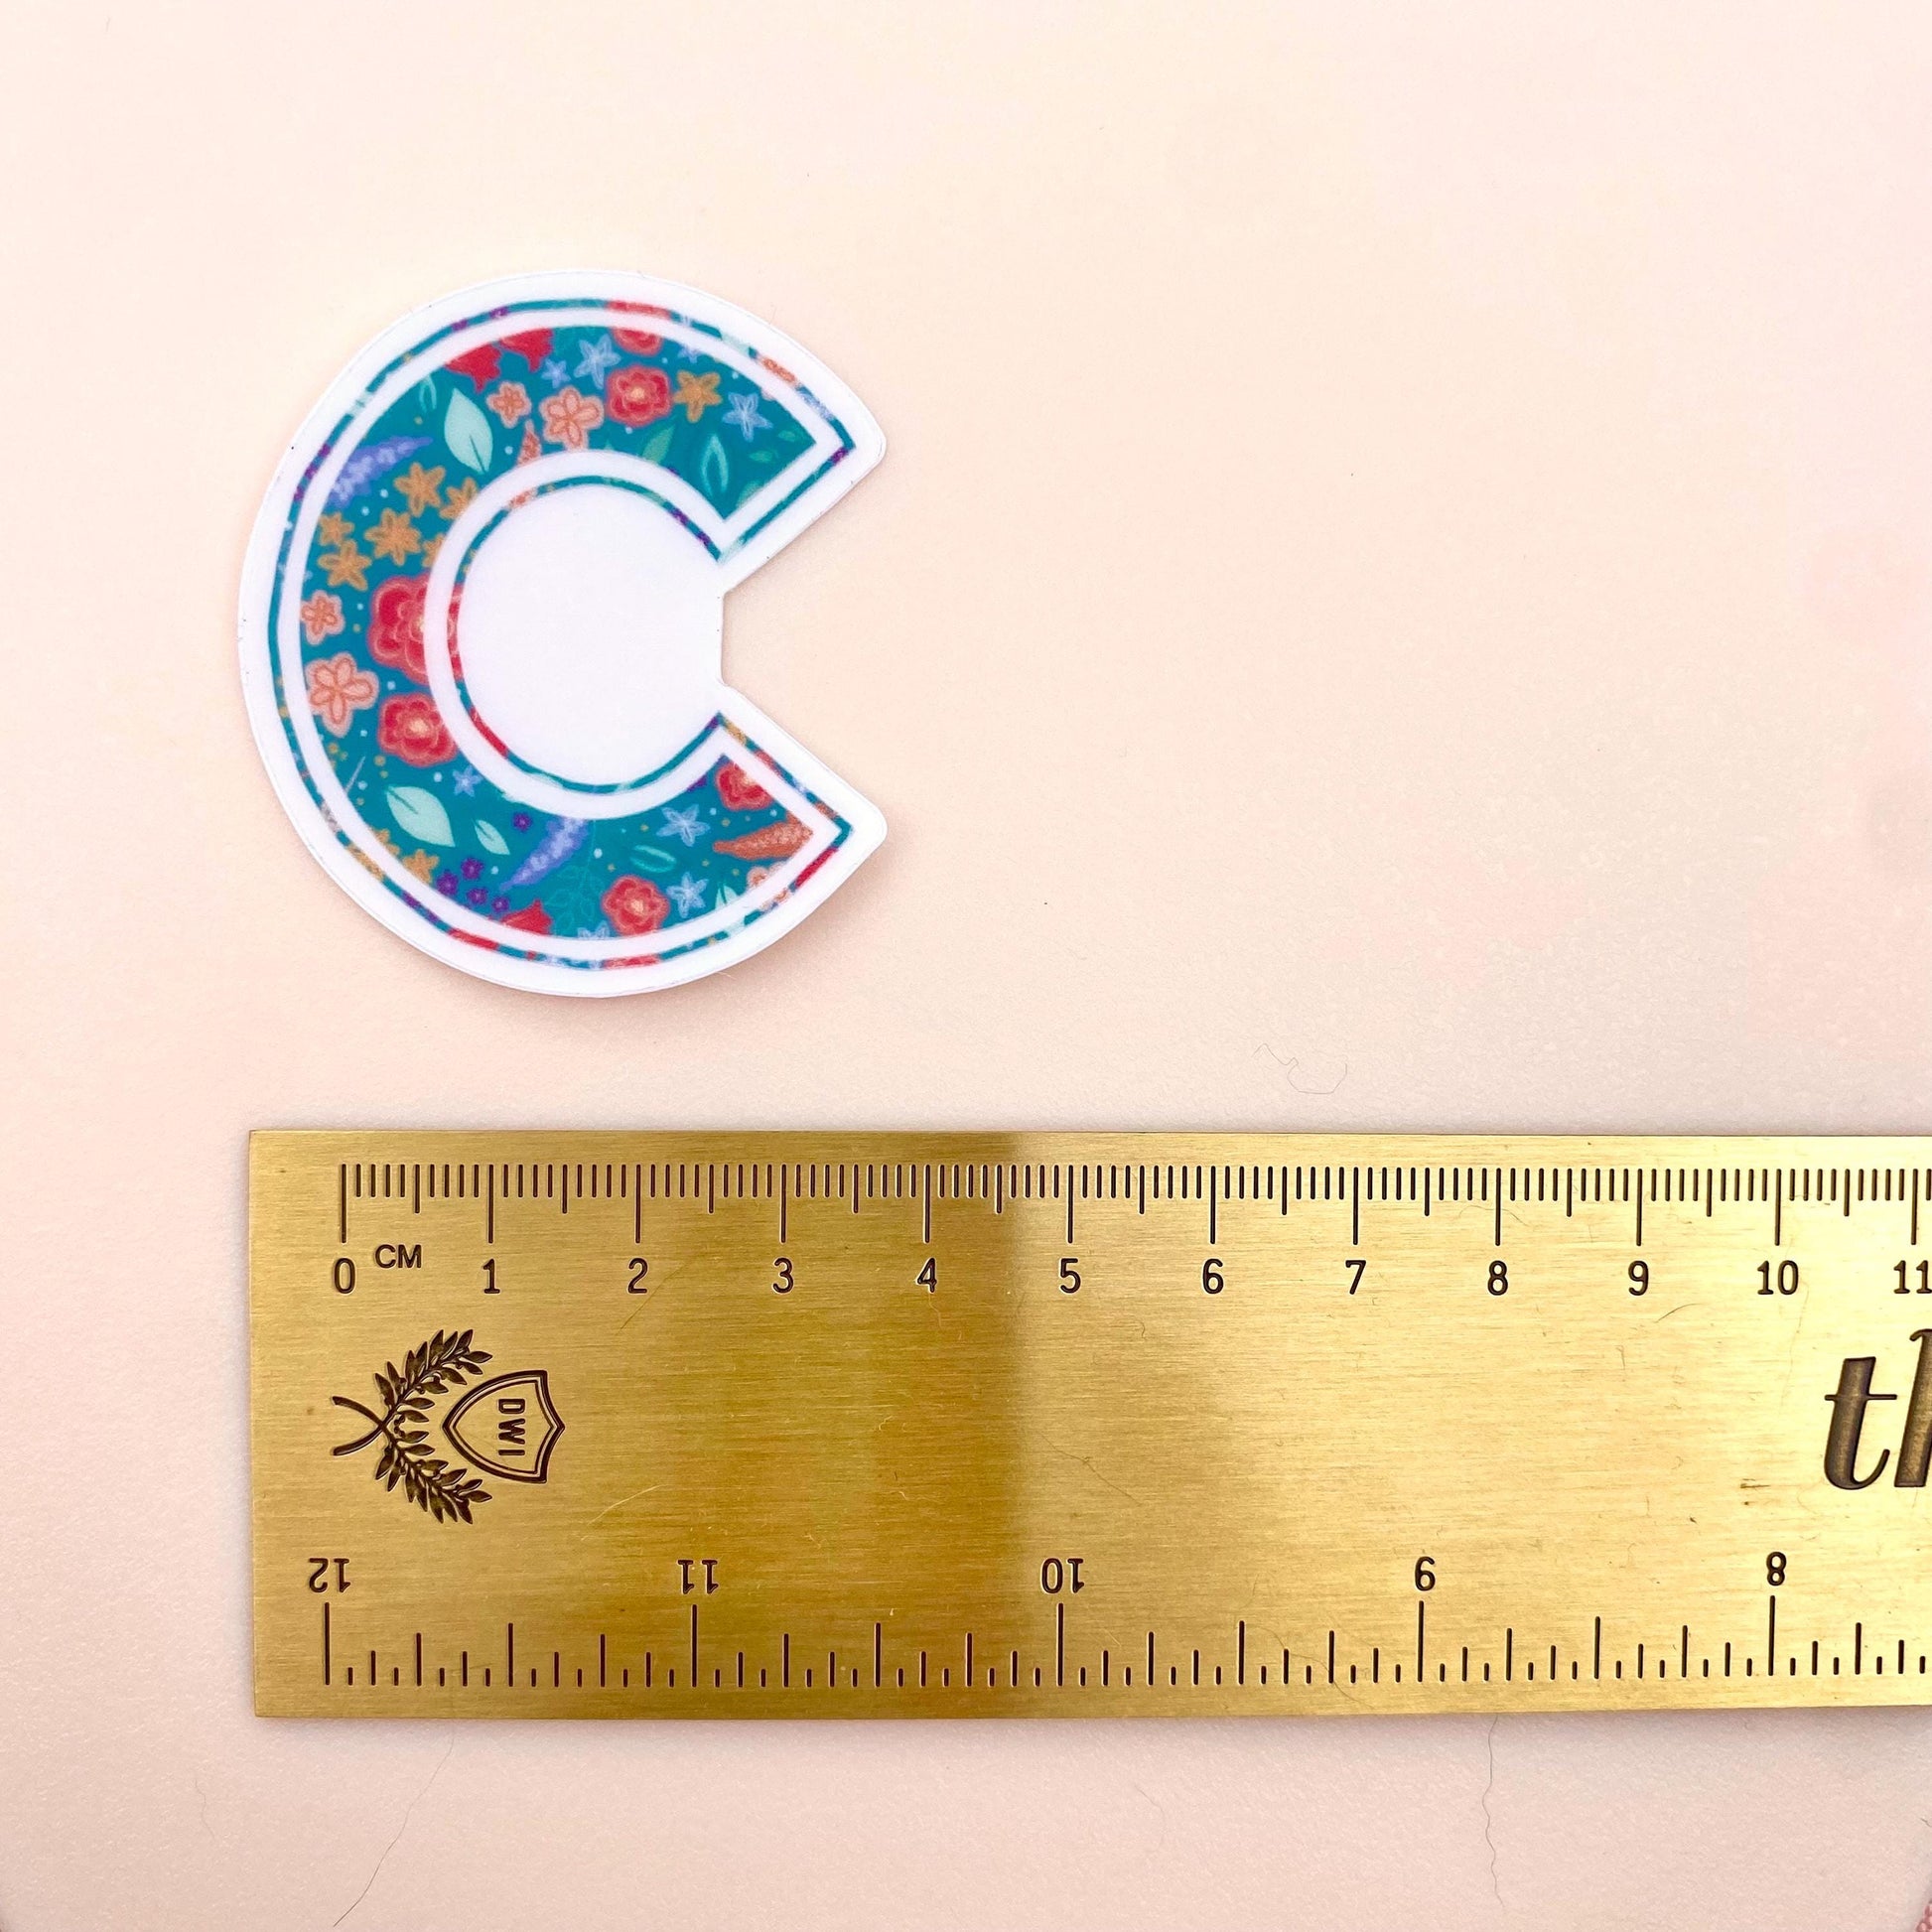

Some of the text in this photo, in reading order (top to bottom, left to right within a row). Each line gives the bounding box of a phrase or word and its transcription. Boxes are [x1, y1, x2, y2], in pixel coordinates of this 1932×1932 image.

[332, 1257, 1932, 1297] 0 1 2 3 4 5 6 7 8 9 10 11
[374, 1243, 422, 1269] CM
[497, 1398, 526, 1456] DWI
[307, 1557, 351, 1593] 12
[677, 1559, 719, 1595] 11
[1041, 1557, 1085, 1594] 10
[1765, 1551, 1788, 1587] 8
